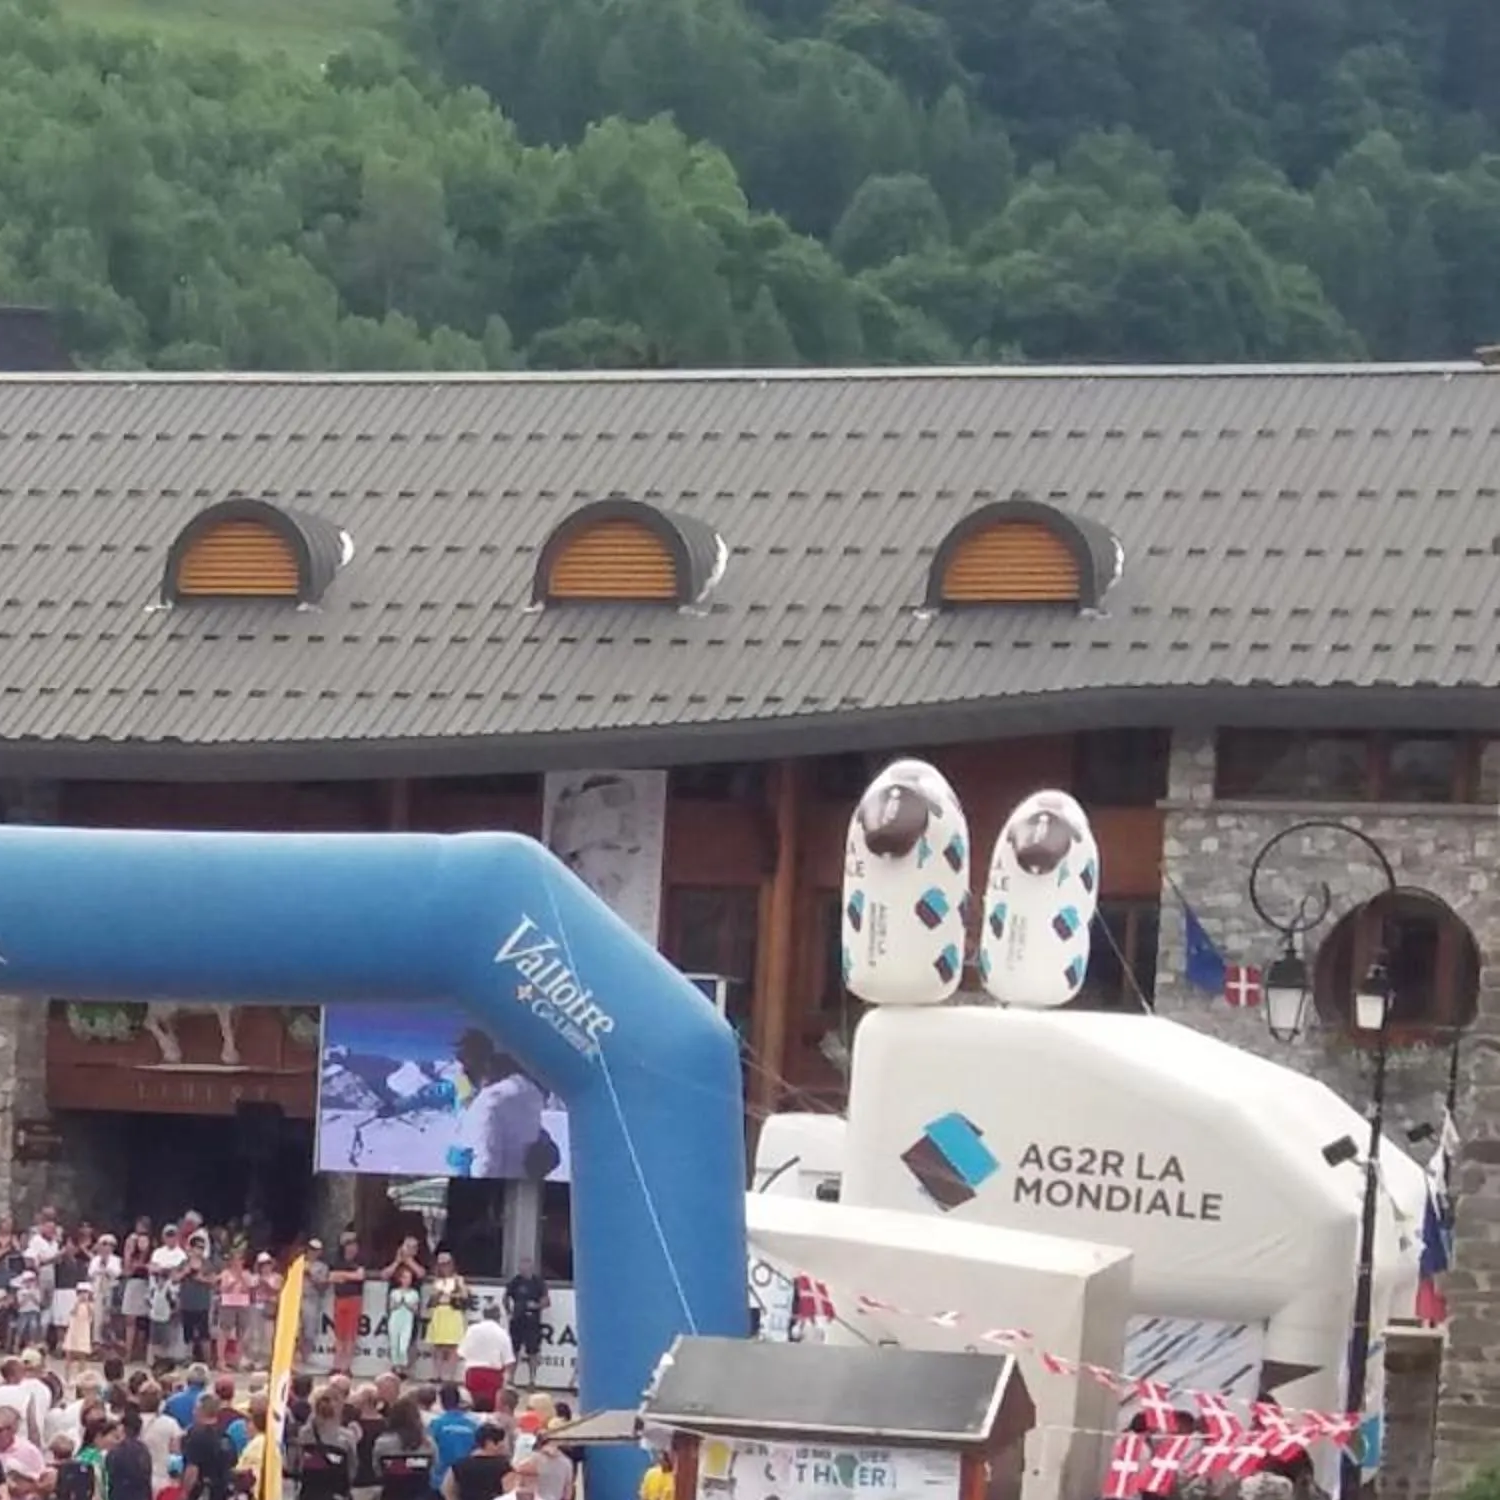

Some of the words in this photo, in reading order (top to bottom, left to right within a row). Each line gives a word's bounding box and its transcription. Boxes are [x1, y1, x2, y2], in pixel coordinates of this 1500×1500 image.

[493, 912, 615, 1035] Valloire
[1018, 1143, 1125, 1178] AG2R
[1135, 1151, 1185, 1183] LA
[1013, 1175, 1224, 1222] MONDIALE
